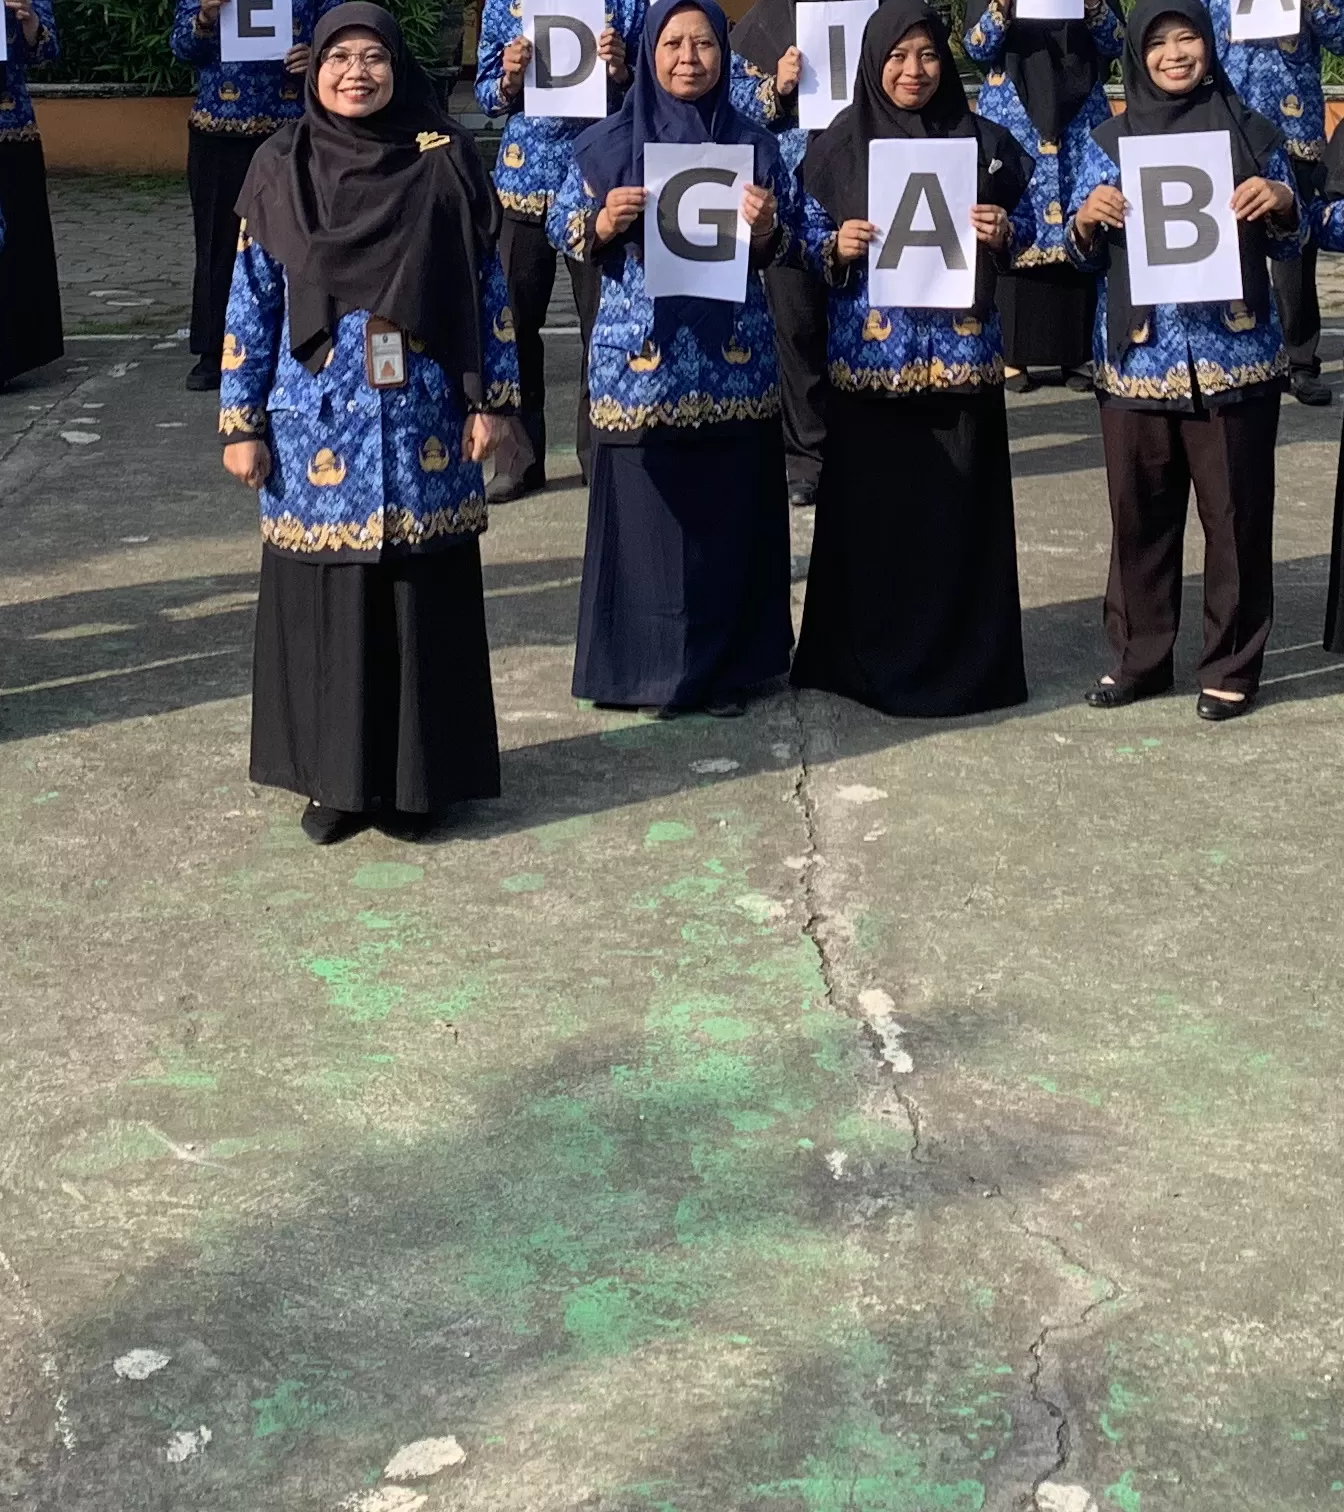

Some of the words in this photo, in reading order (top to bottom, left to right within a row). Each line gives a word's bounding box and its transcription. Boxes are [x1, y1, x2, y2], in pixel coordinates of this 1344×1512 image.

[533, 15, 597, 89] D
[657, 168, 738, 262] G
[875, 172, 968, 270] A
[1140, 166, 1219, 266] B
